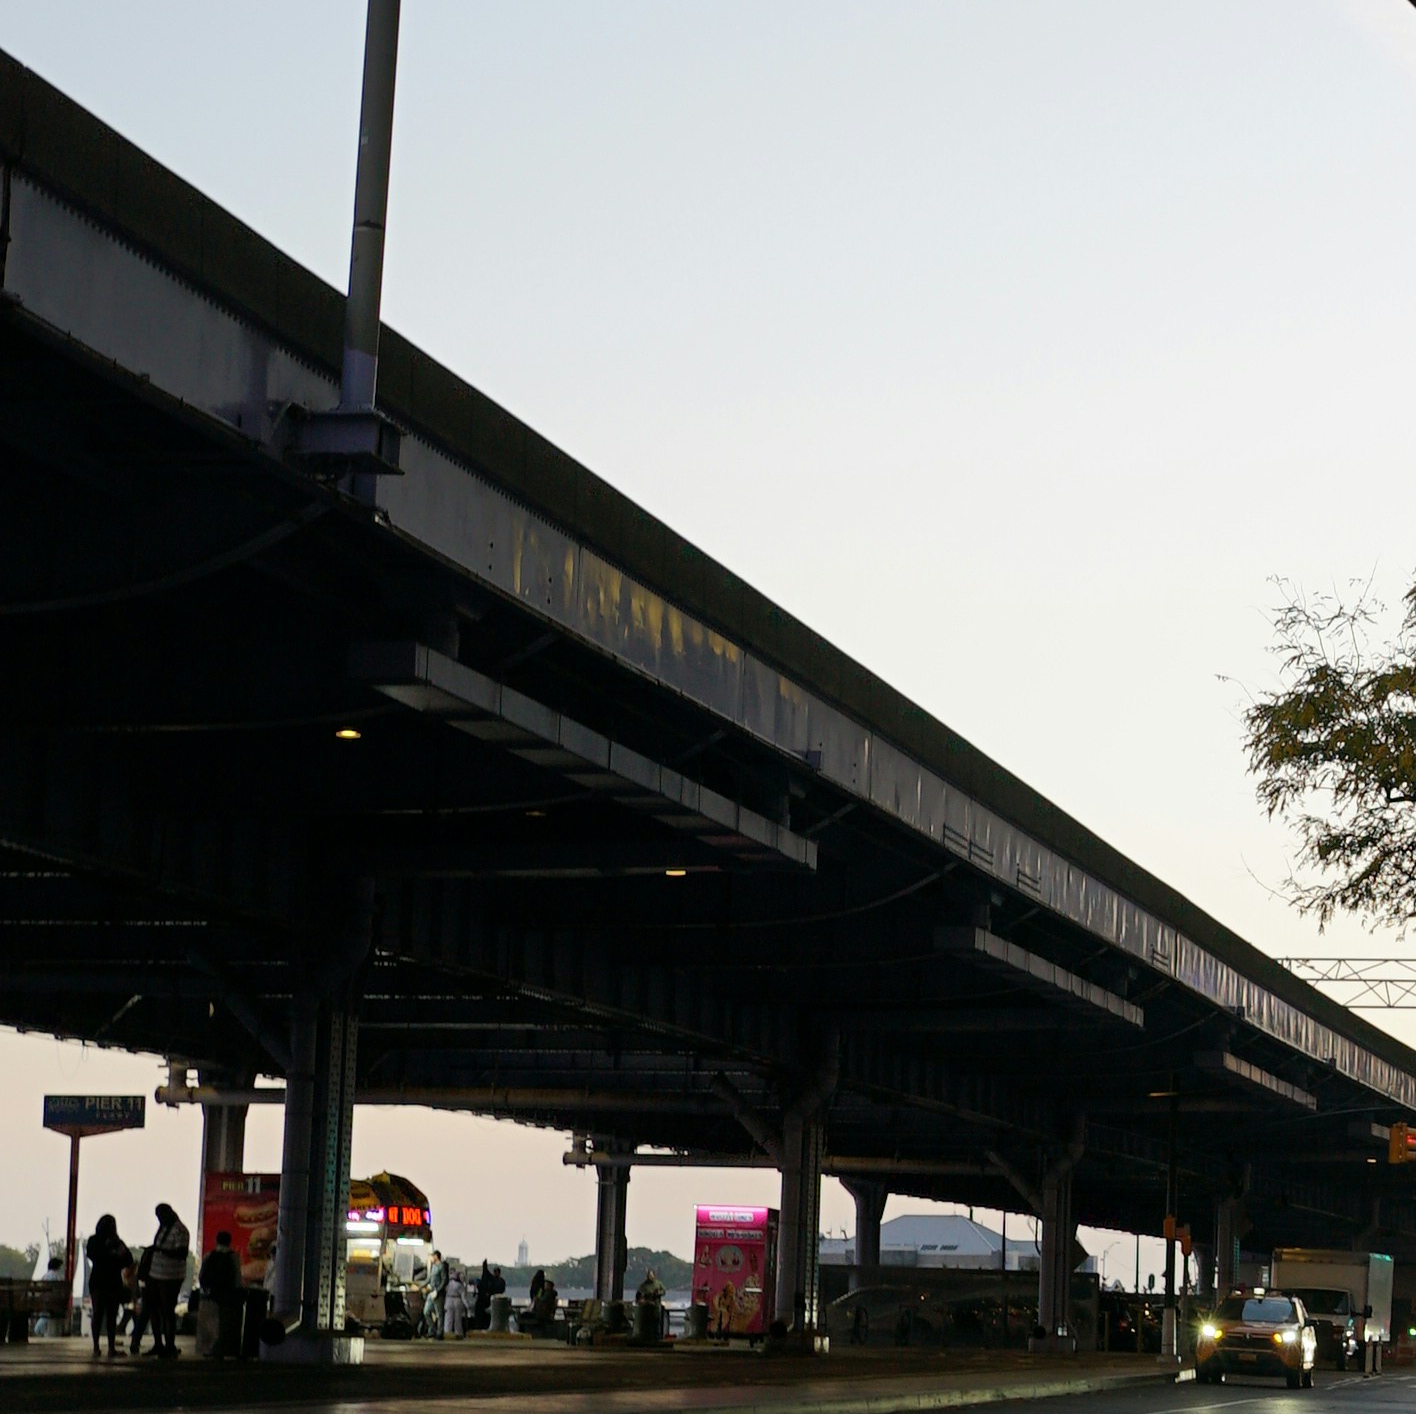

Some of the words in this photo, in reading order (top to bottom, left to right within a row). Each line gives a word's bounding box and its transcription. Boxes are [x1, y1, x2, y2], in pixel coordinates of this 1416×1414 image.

[85, 1096, 122, 1110] PIER
[128, 1097, 142, 1110] 11
[247, 1177, 261, 1194] 11
